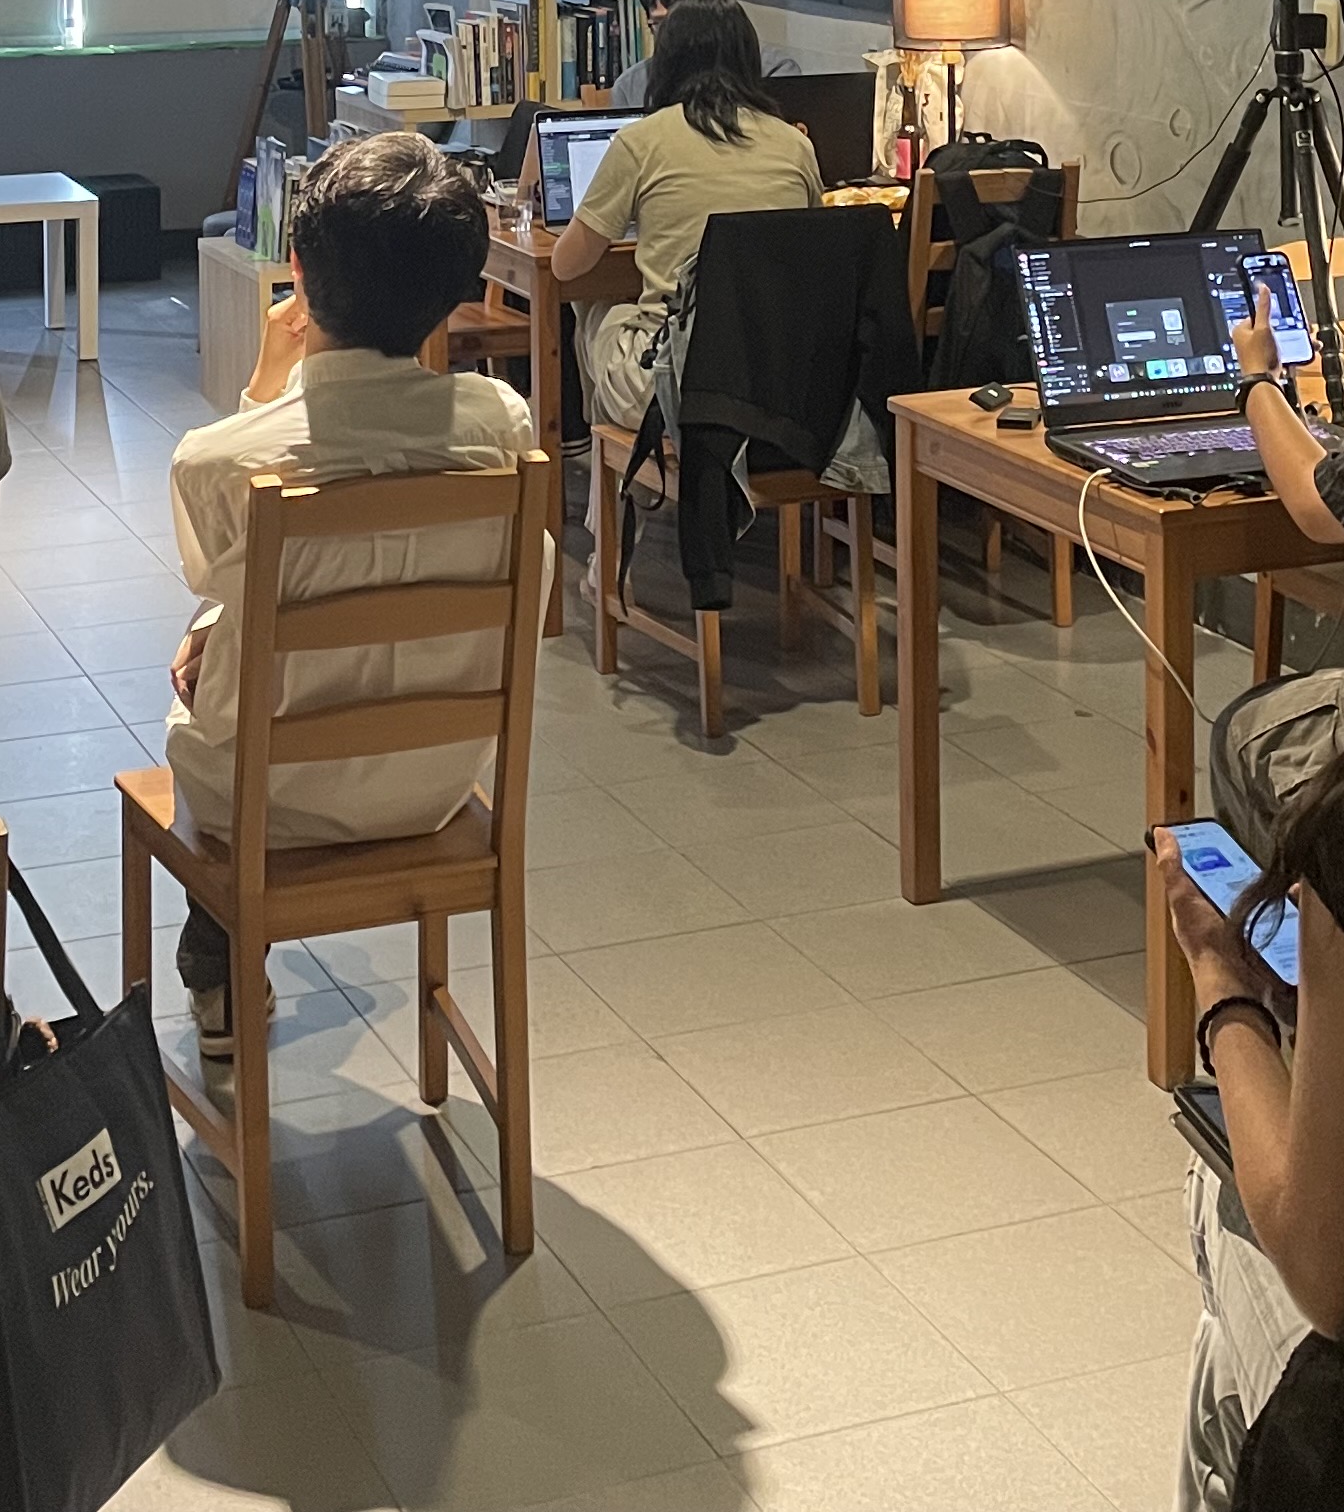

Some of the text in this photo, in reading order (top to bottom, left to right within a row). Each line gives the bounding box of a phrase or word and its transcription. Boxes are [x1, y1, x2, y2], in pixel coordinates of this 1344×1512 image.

[50, 1149, 116, 1217] Keds
[51, 1168, 155, 1310] Wear yours.
